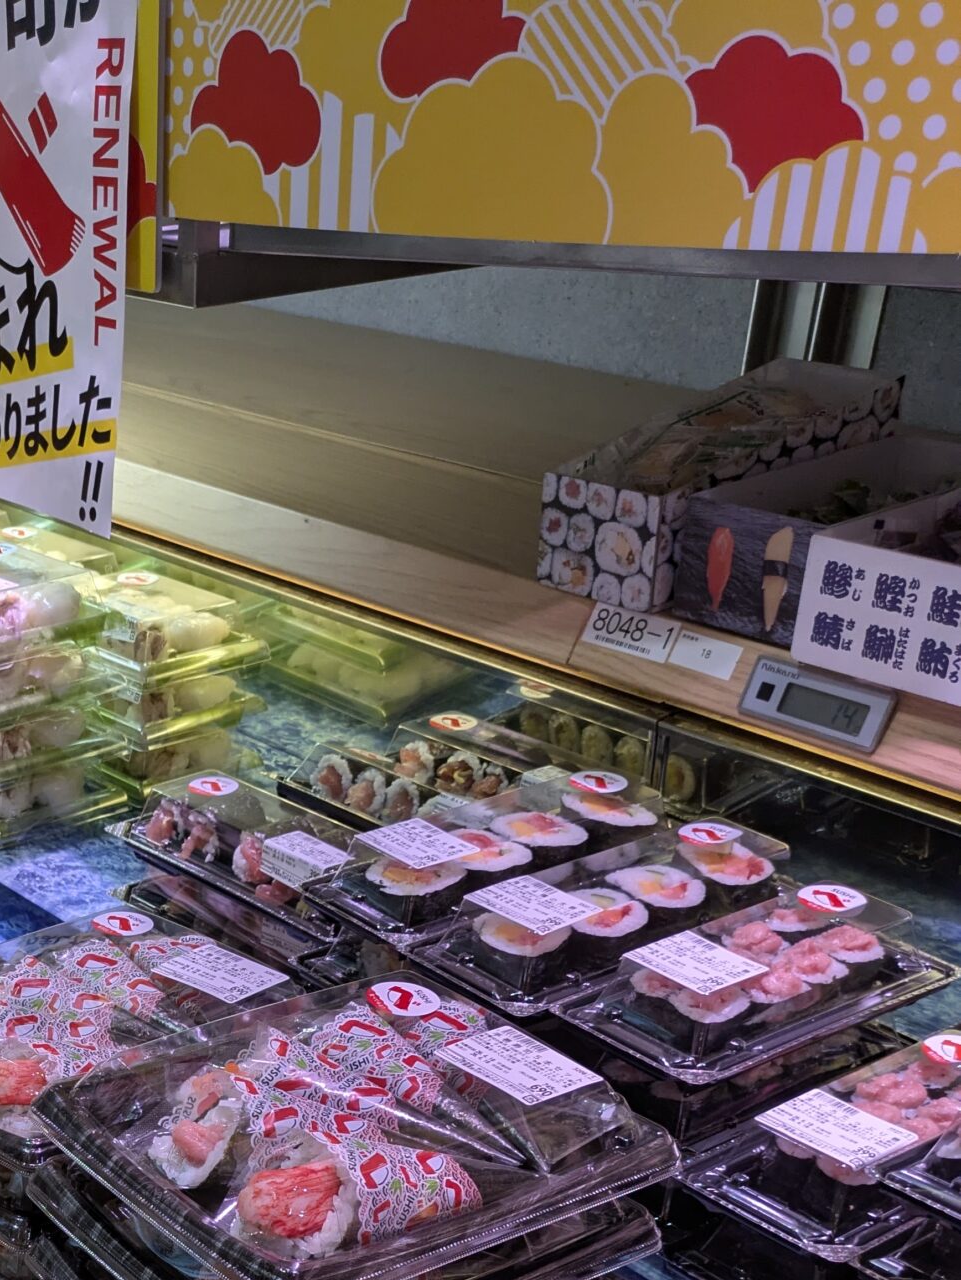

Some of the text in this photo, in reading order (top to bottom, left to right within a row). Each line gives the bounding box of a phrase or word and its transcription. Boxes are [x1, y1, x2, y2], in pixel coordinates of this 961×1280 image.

[92, 37, 126, 347] RENEWAL
[851, 567, 866, 601] あじ
[903, 577, 921, 618] かつお
[593, 608, 675, 650] 8048-1
[841, 618, 856, 652] さば
[528, 1083, 555, 1096] 690
[851, 1146, 877, 1160] 399
[396, 1190, 418, 1228] SUSHI
